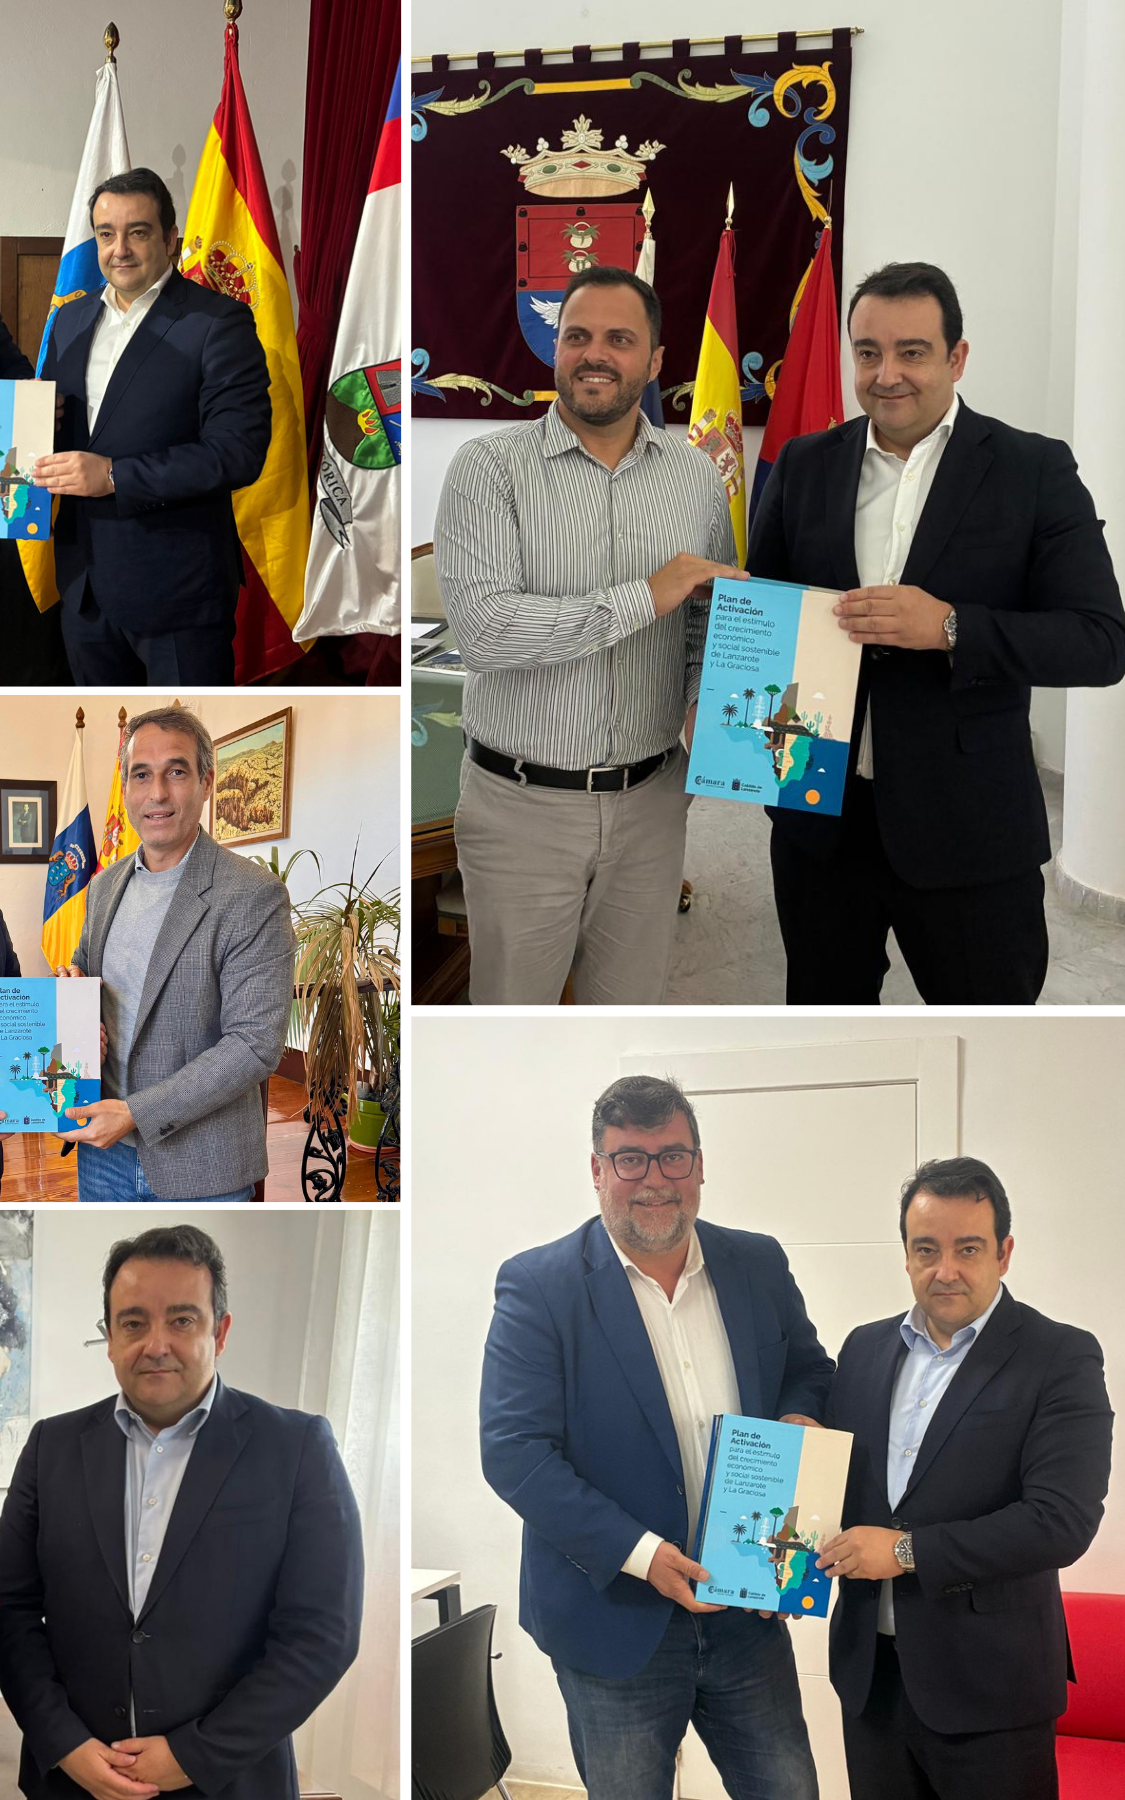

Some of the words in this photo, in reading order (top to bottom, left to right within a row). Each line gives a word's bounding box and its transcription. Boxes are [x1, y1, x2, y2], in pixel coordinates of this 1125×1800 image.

[321, 455, 347, 506] ÓRICA
[717, 593, 738, 604] Plan
[739, 596, 752, 606] de
[715, 602, 763, 617] Activación
[714, 614, 732, 622] para
[733, 615, 741, 623] el
[713, 622, 727, 631] del
[727, 625, 772, 637] crecimiento
[711, 641, 717, 650] y
[717, 642, 740, 651] social
[741, 645, 780, 656] sostenible
[710, 649, 721, 658] de
[722, 651, 760, 663] Lanzarote
[709, 660, 715, 668] y
[715, 659, 725, 668] La
[726, 660, 759, 672] Graciosa
[731, 1428, 749, 1438] Plan
[750, 1430, 762, 1439] de
[729, 1436, 772, 1449] Activación
[727, 1454, 739, 1462] del
[739, 1456, 779, 1466] crecimiento
[723, 1478, 734, 1486] de
[734, 1479, 767, 1489] Lanzarote
[730, 1471, 750, 1479] social
[750, 1474, 785, 1483] sostenible
[728, 1486, 737, 1494] La
[737, 1487, 766, 1497] Graciosa
